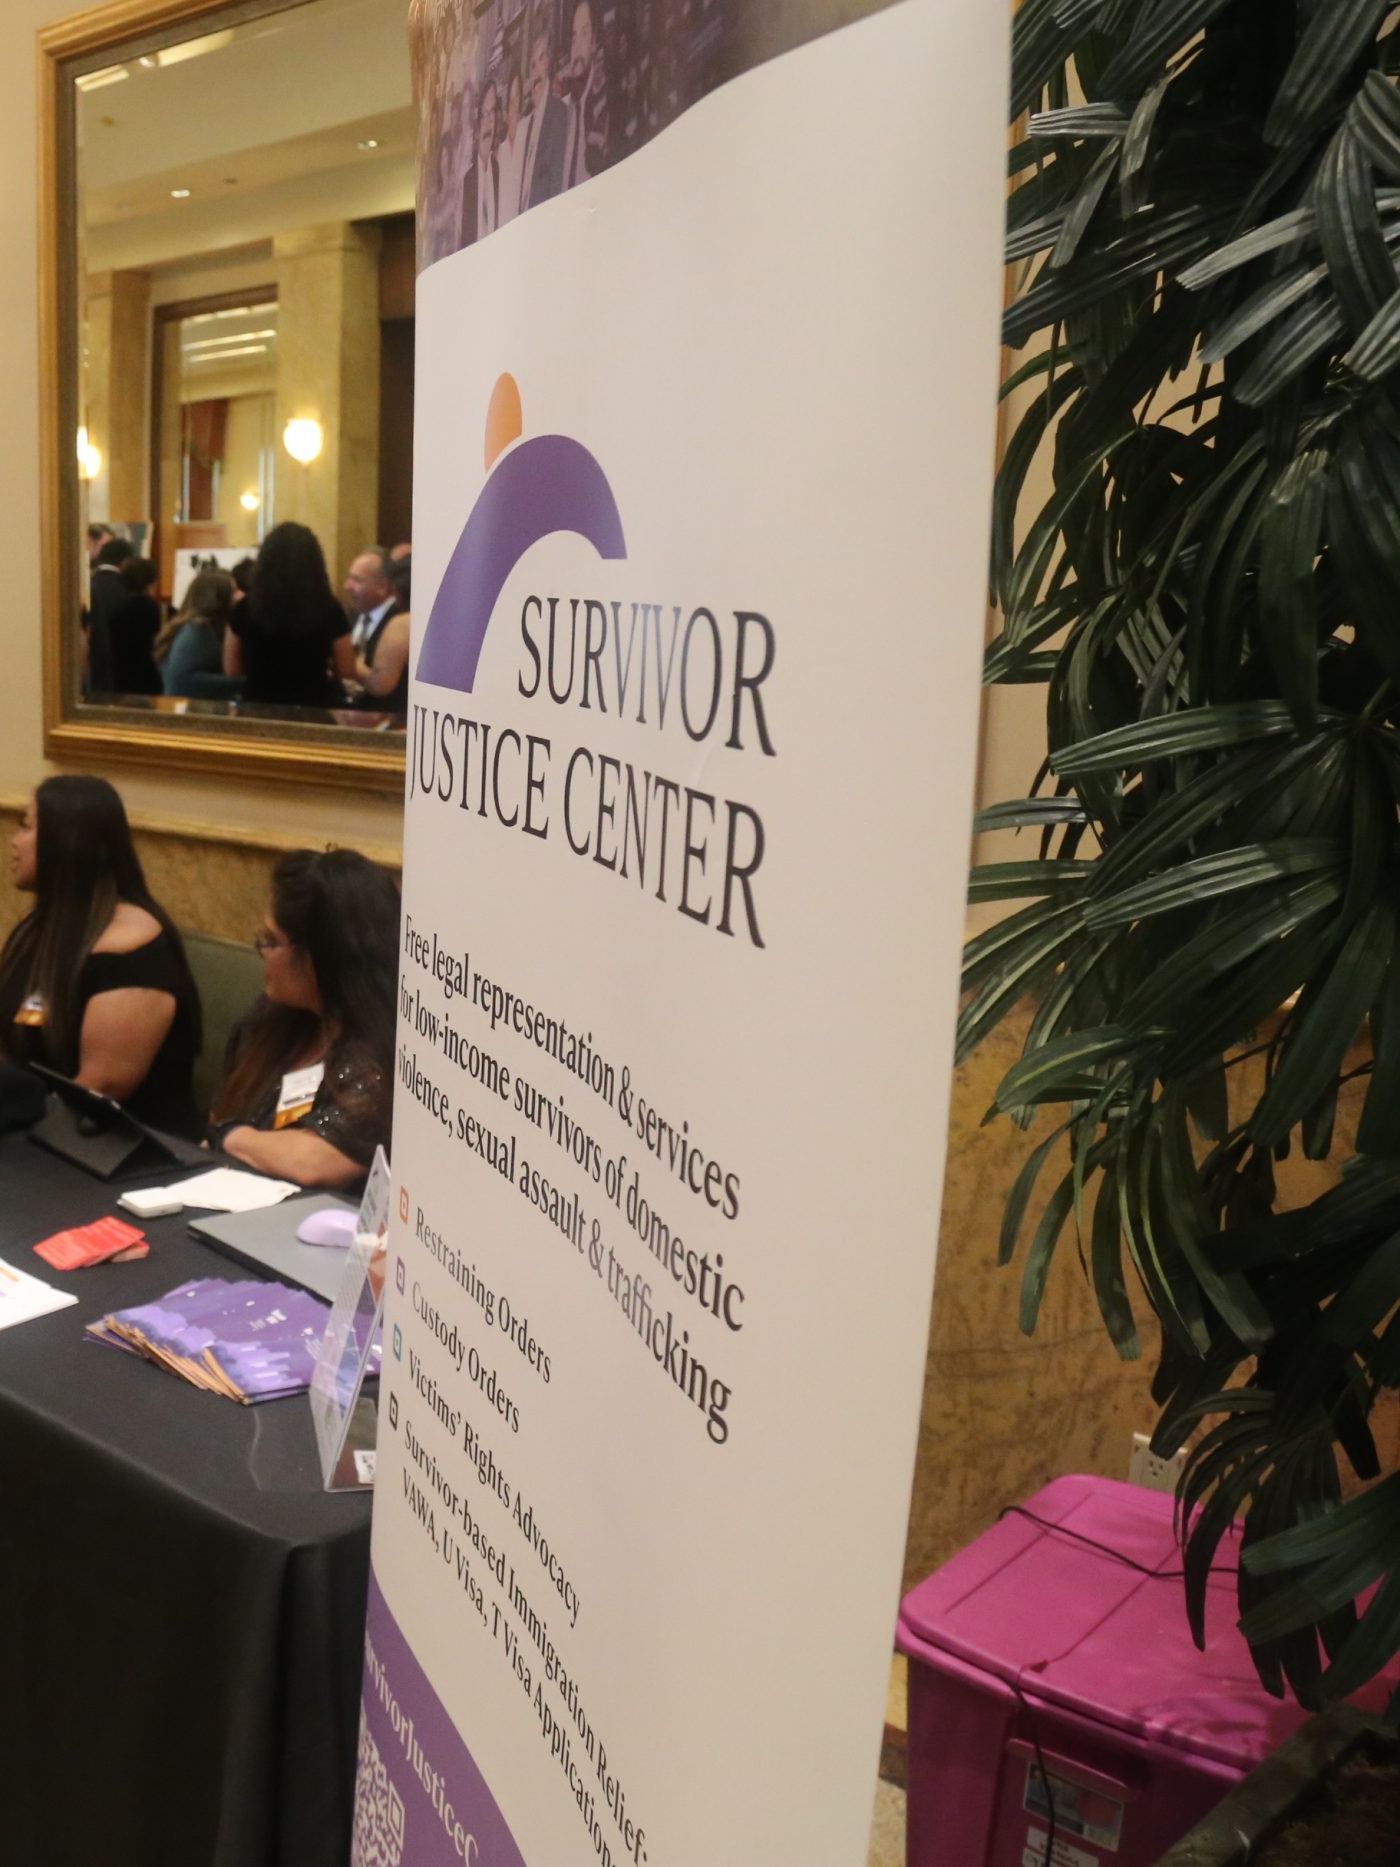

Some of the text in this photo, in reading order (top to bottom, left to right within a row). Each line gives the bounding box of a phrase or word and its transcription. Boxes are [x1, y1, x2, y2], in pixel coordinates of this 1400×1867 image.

[518, 595, 777, 757] SURVIVOR
[410, 704, 766, 950] JUSTICE CENTER
[405, 914, 740, 1220] Free legal representation & services
[415, 989, 510, 1101] low-income
[514, 1076, 601, 1183] survivors
[605, 1155, 627, 1209] of
[626, 1171, 745, 1332] domestic
[412, 1281, 520, 1434] Custody Orders
[415, 1206, 551, 1384] Restraining Orders
[457, 1107, 516, 1184] sexual
[519, 1160, 586, 1254] assault
[589, 1218, 605, 1279] &
[607, 1246, 732, 1444] trafficking
[403, 1466, 440, 1553] VAWA,
[443, 1528, 453, 1564] U
[456, 1545, 488, 1627] Visa,
[491, 1601, 501, 1638] T
[504, 1618, 531, 1697] Visa
[404, 1420, 647, 1867] Survivor-based Immigration Relief.
[464, 1421, 511, 1509] Rights
[512, 1491, 580, 1629] Advocacy
